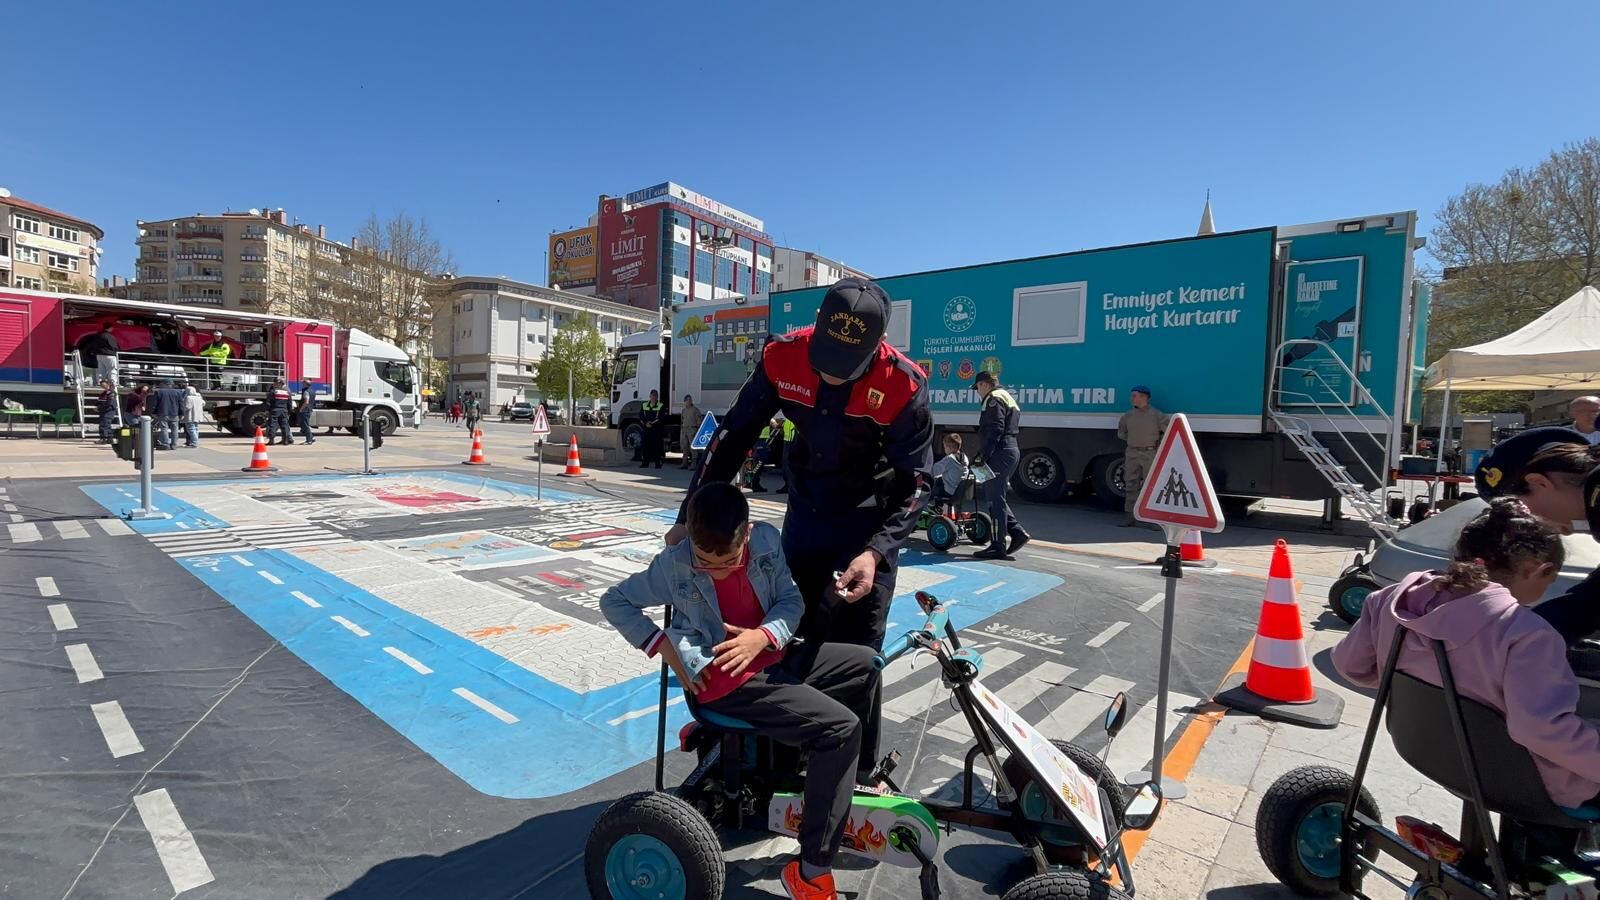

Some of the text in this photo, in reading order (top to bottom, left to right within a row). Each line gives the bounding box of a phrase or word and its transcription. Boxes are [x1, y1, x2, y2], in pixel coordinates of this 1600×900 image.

[569, 232, 592, 249] UFUK
[611, 234, 647, 256] LİMİT
[1103, 282, 1245, 312] Emniyet Kemeri
[830, 312, 867, 334] JANDARMA
[1105, 309, 1241, 335] Hayat Kurtarır
[924, 335, 949, 346] TÜRKİYE
[924, 343, 996, 355] İÇİŞLERİ BAKANLIĞI
[1008, 383, 1064, 404] ĞİTİM
[1071, 387, 1115, 404] TIRI
